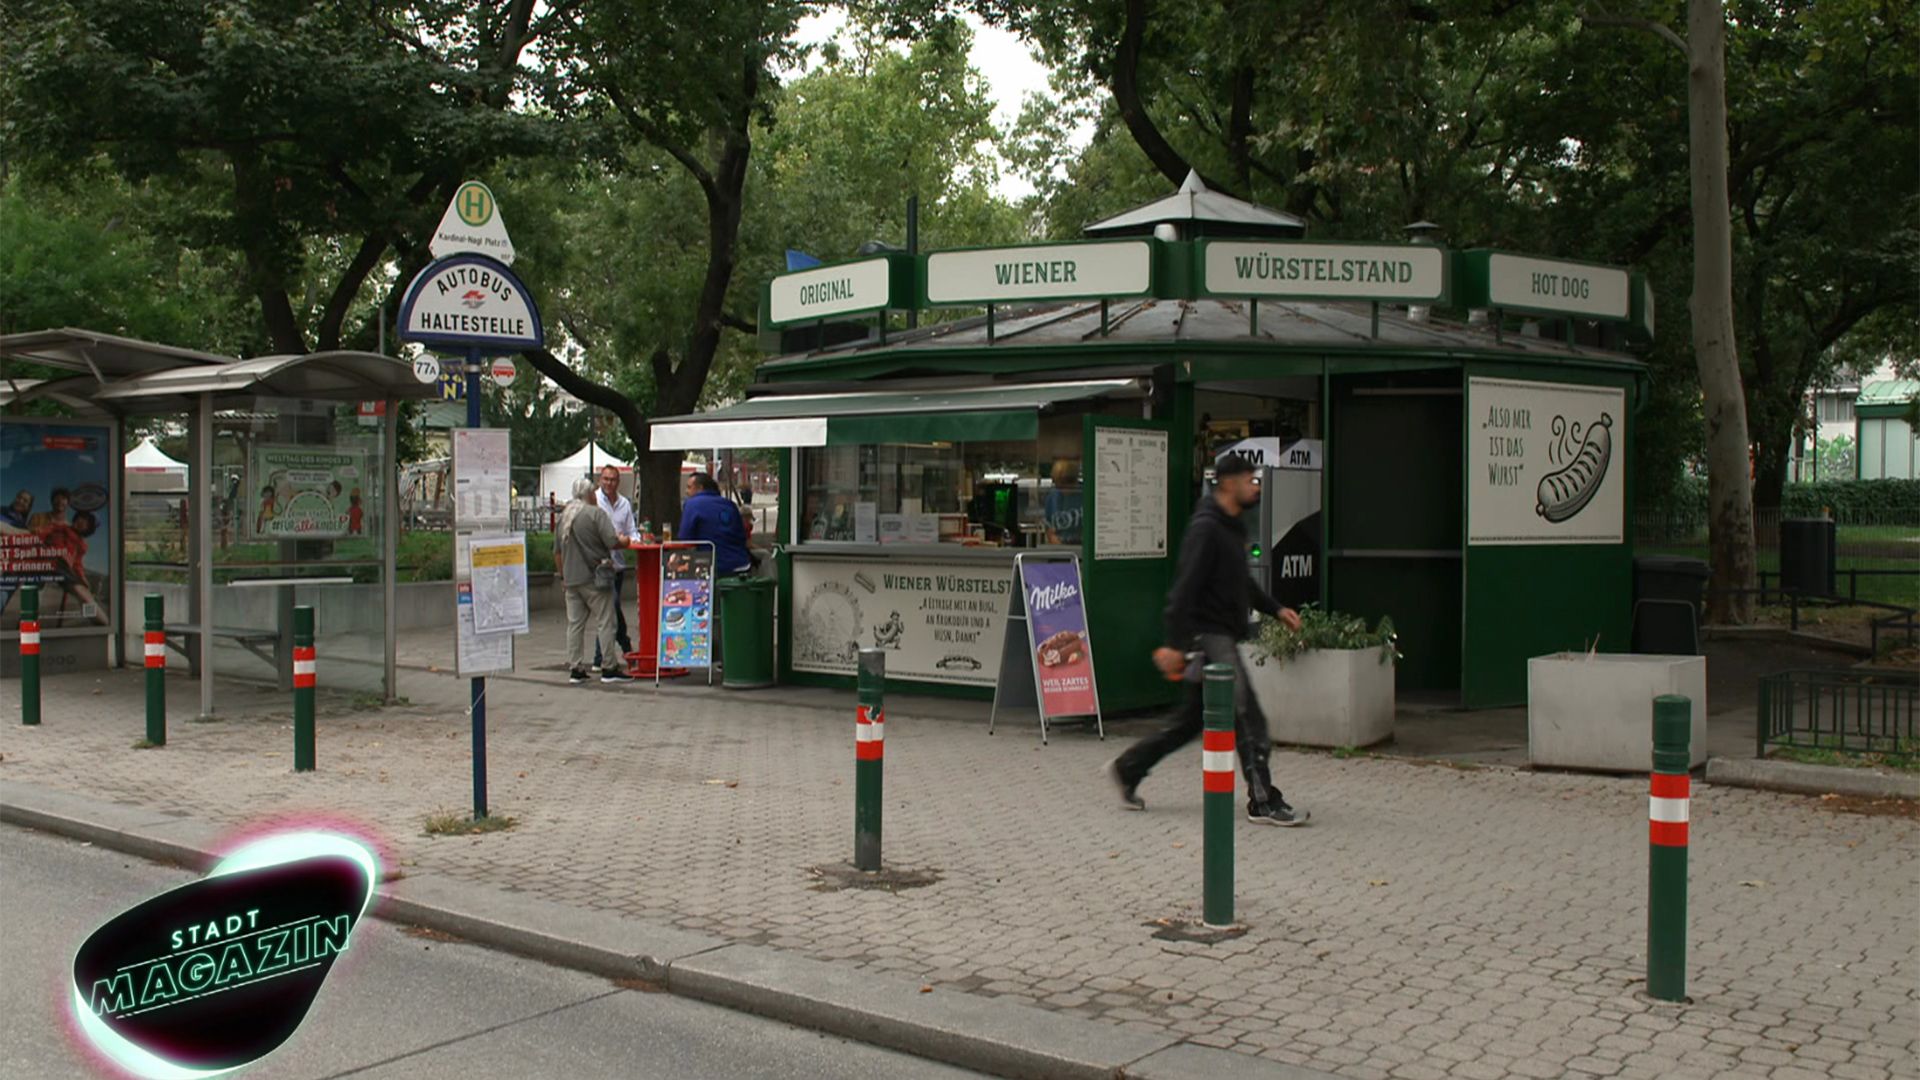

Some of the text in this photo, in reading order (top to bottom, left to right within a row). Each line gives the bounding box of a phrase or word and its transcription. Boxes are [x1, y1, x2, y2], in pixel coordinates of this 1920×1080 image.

[438, 233, 483, 246] Kardinal-Nagl
[485, 237, 500, 247] Platz
[995, 260, 1077, 286] WIENER
[1234, 252, 1413, 284] WÜRSTELSTAND
[436, 267, 512, 302] AUTOBUS
[800, 277, 855, 306] ORIGINAL
[1531, 272, 1589, 299] HOT DOG
[421, 312, 525, 335] HALTESTELLE
[416, 361, 436, 376] 77A
[444, 382, 456, 400] N
[1513, 408, 1532, 430] MIR
[1289, 449, 1311, 466] ATM
[1489, 436, 1524, 458] IST DAS
[14, 547, 38, 560] Spaß
[1281, 554, 1313, 578] ATM
[883, 574, 932, 591] WIENER
[1030, 581, 1078, 611] Milka
